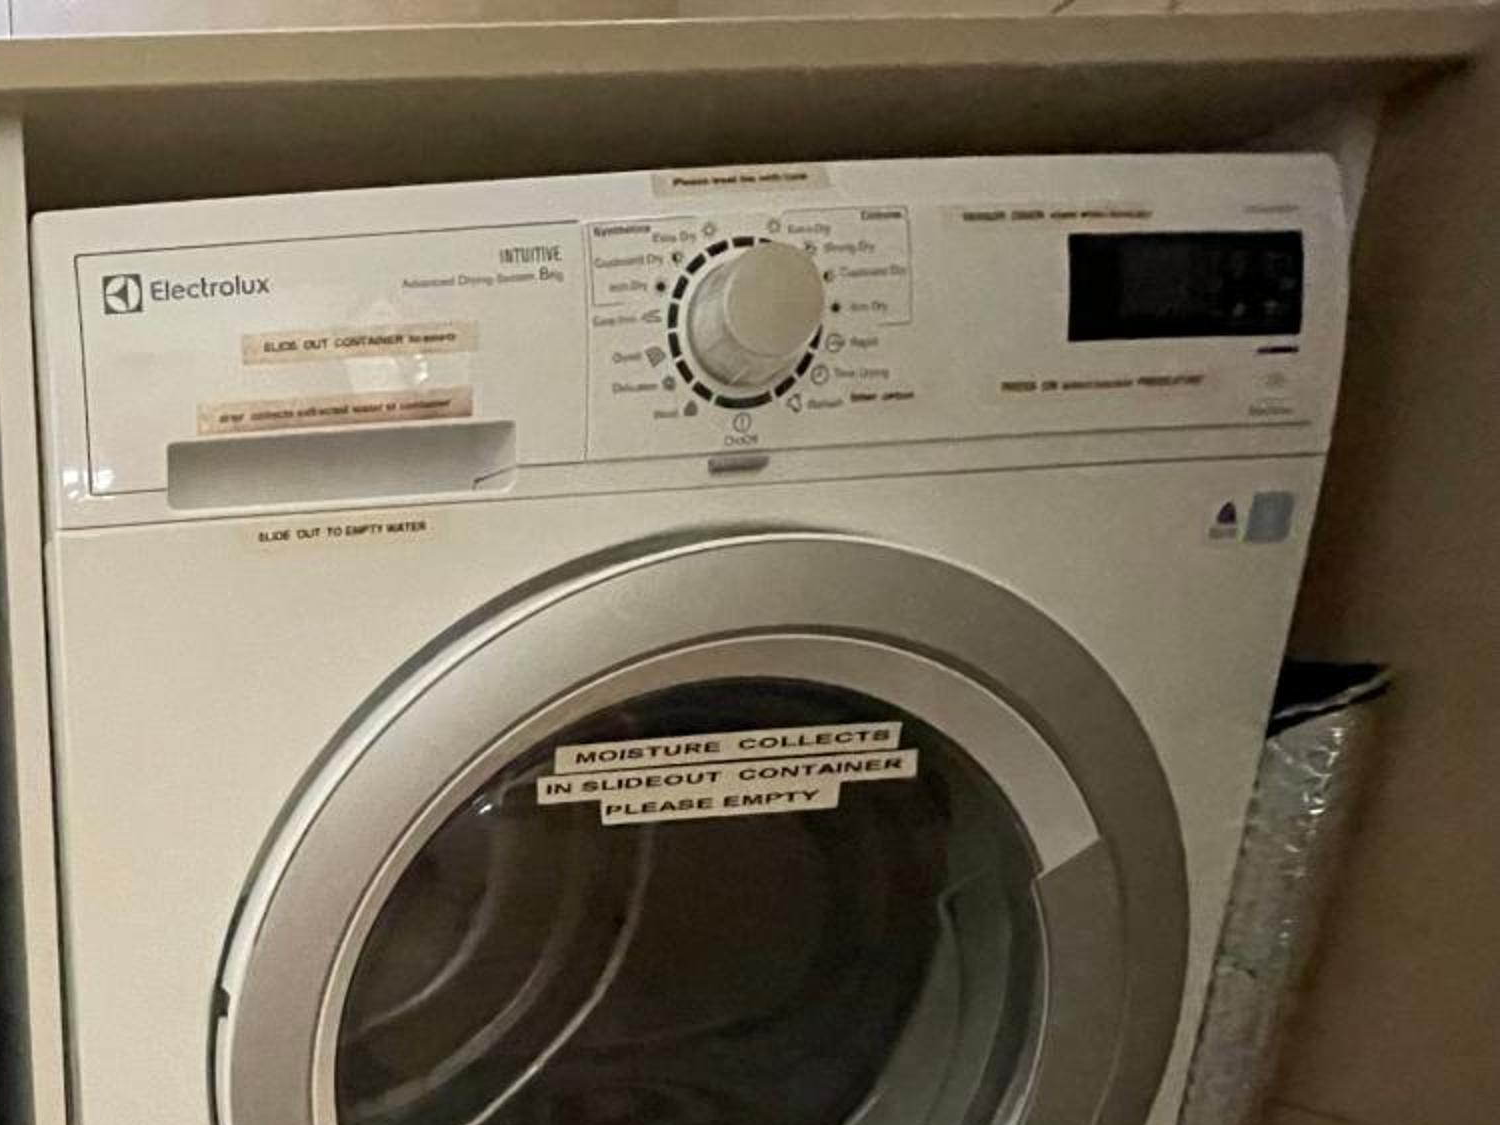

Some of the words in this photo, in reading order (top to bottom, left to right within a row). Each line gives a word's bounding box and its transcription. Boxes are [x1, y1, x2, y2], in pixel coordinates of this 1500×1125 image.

[499, 245, 563, 264] INTUITIVE
[150, 274, 271, 302] Electrolux
[303, 338, 328, 351] OUT
[333, 333, 404, 349] CONTAINER
[257, 529, 292, 543] SLIDE
[295, 526, 321, 541] OUT
[326, 526, 343, 538] TO
[345, 523, 382, 537] EMPTY
[386, 520, 428, 533] WATER
[575, 740, 722, 765] MOISTURE
[737, 728, 891, 751] COLLECTS
[545, 782, 572, 796] IN
[580, 770, 723, 793] SLIDEOUT
[738, 756, 903, 780] CONTAINER
[605, 797, 715, 817] PLEASE
[723, 788, 820, 809] EMPTY
